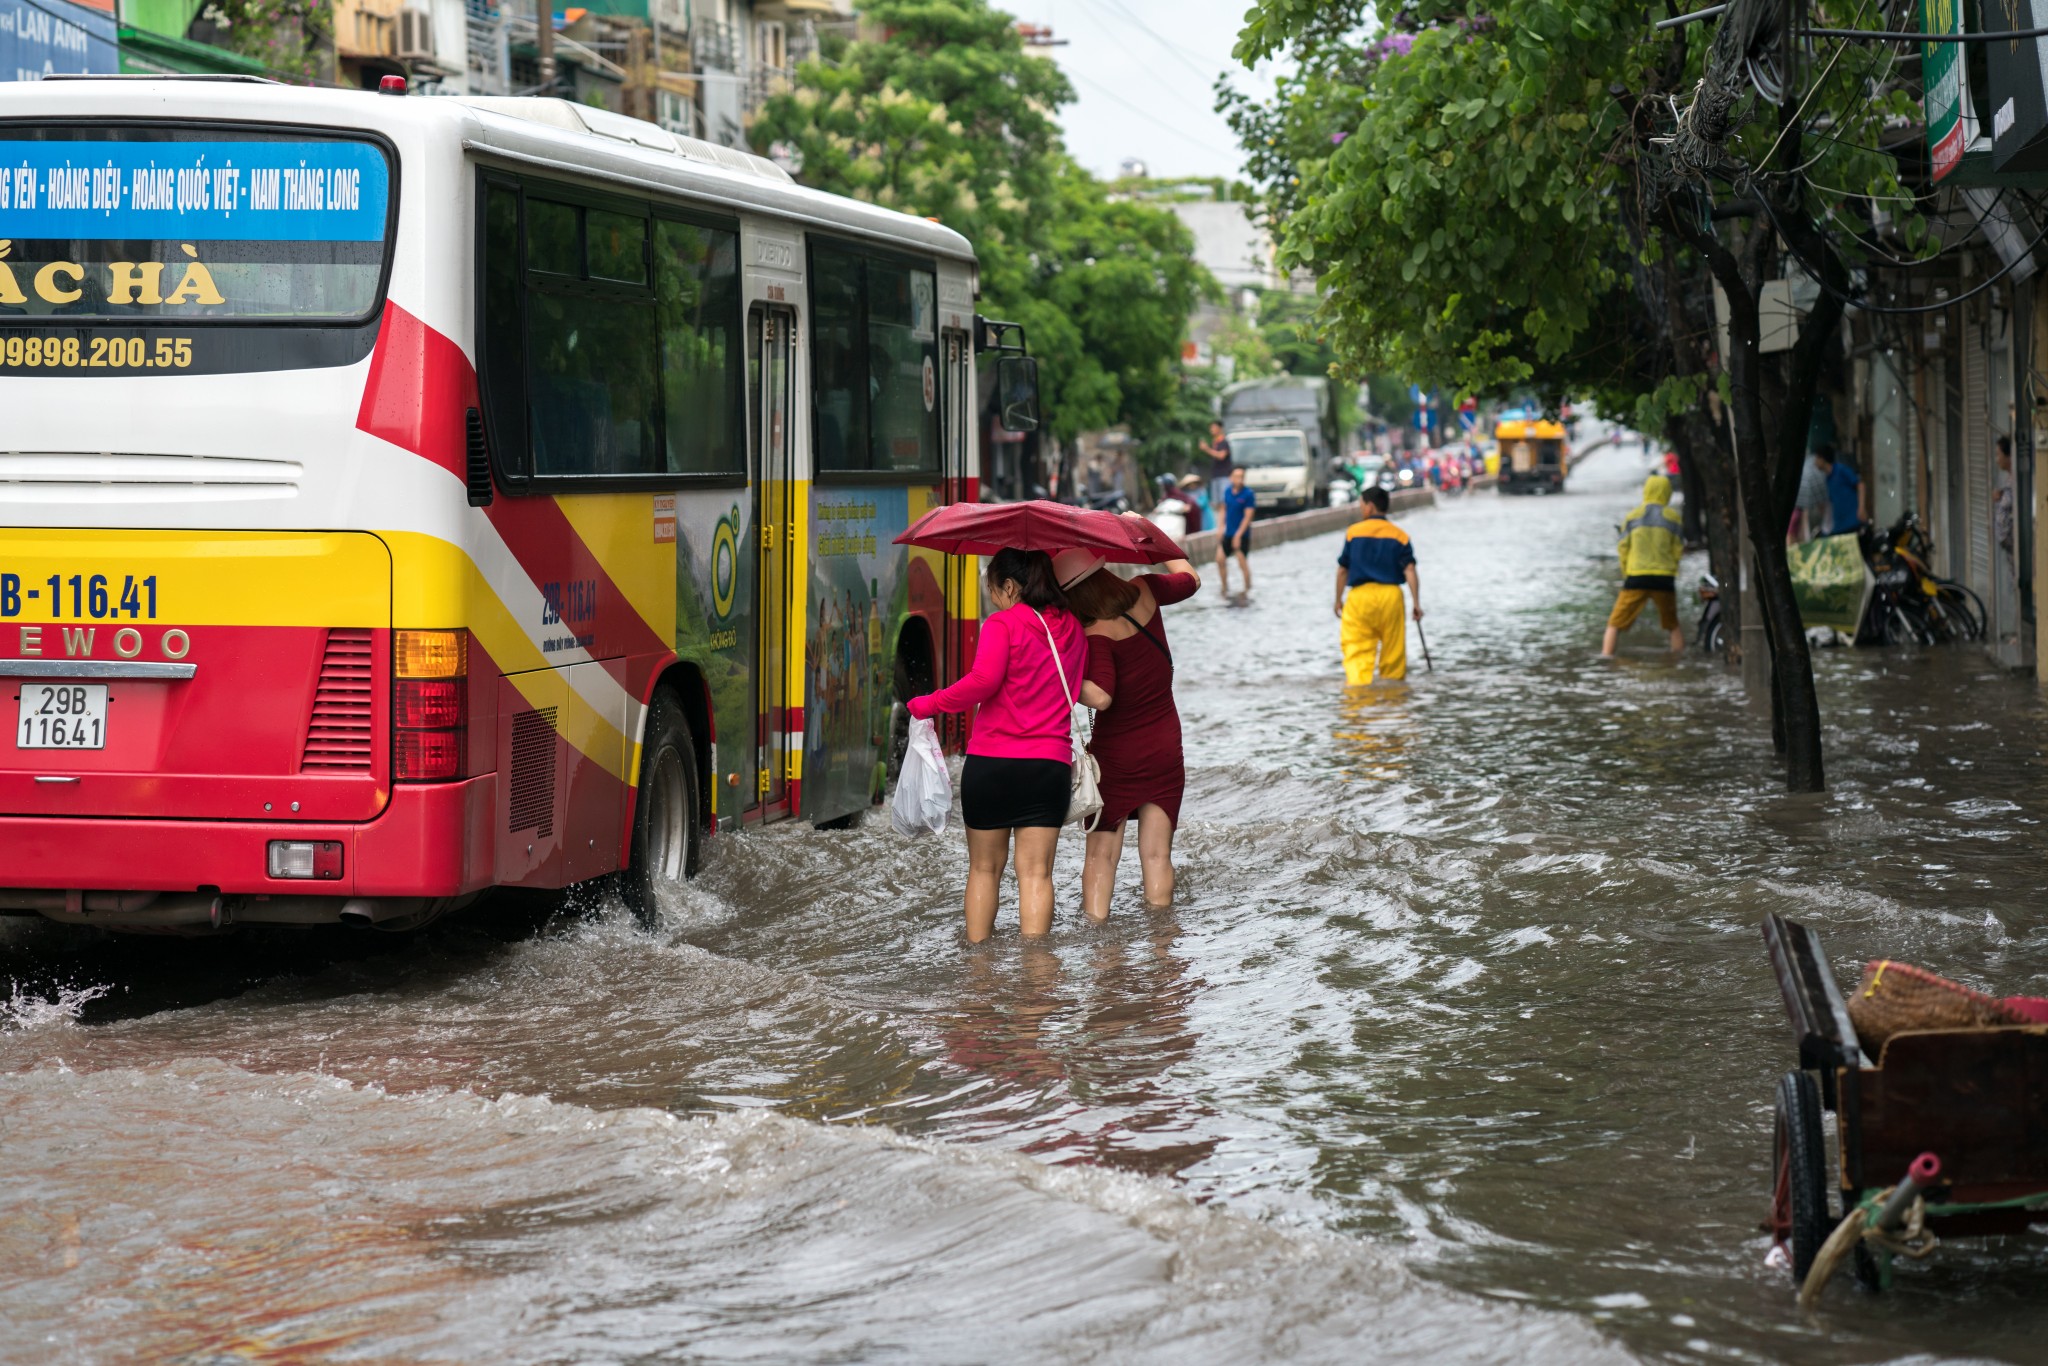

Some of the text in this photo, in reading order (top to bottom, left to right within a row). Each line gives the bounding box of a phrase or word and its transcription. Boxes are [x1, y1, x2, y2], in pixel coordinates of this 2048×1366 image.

[17, 7, 50, 45] LAN
[53, 17, 88, 53] ANH
[14, 160, 37, 209] YÊN
[48, 160, 90, 209] HOÀNG
[92, 160, 121, 217] DIỆU
[132, 160, 175, 210] HOÀNG
[177, 154, 211, 215] QUỐC
[213, 160, 240, 218] VIỆT
[250, 168, 280, 210] NAM
[284, 160, 324, 210] THĂNG
[327, 168, 360, 210] LONG
[107, 243, 226, 305] HÀ
[20, 627, 190, 659] EWOO
[40, 687, 87, 714] 29B
[24, 718, 101, 746] 116.41
